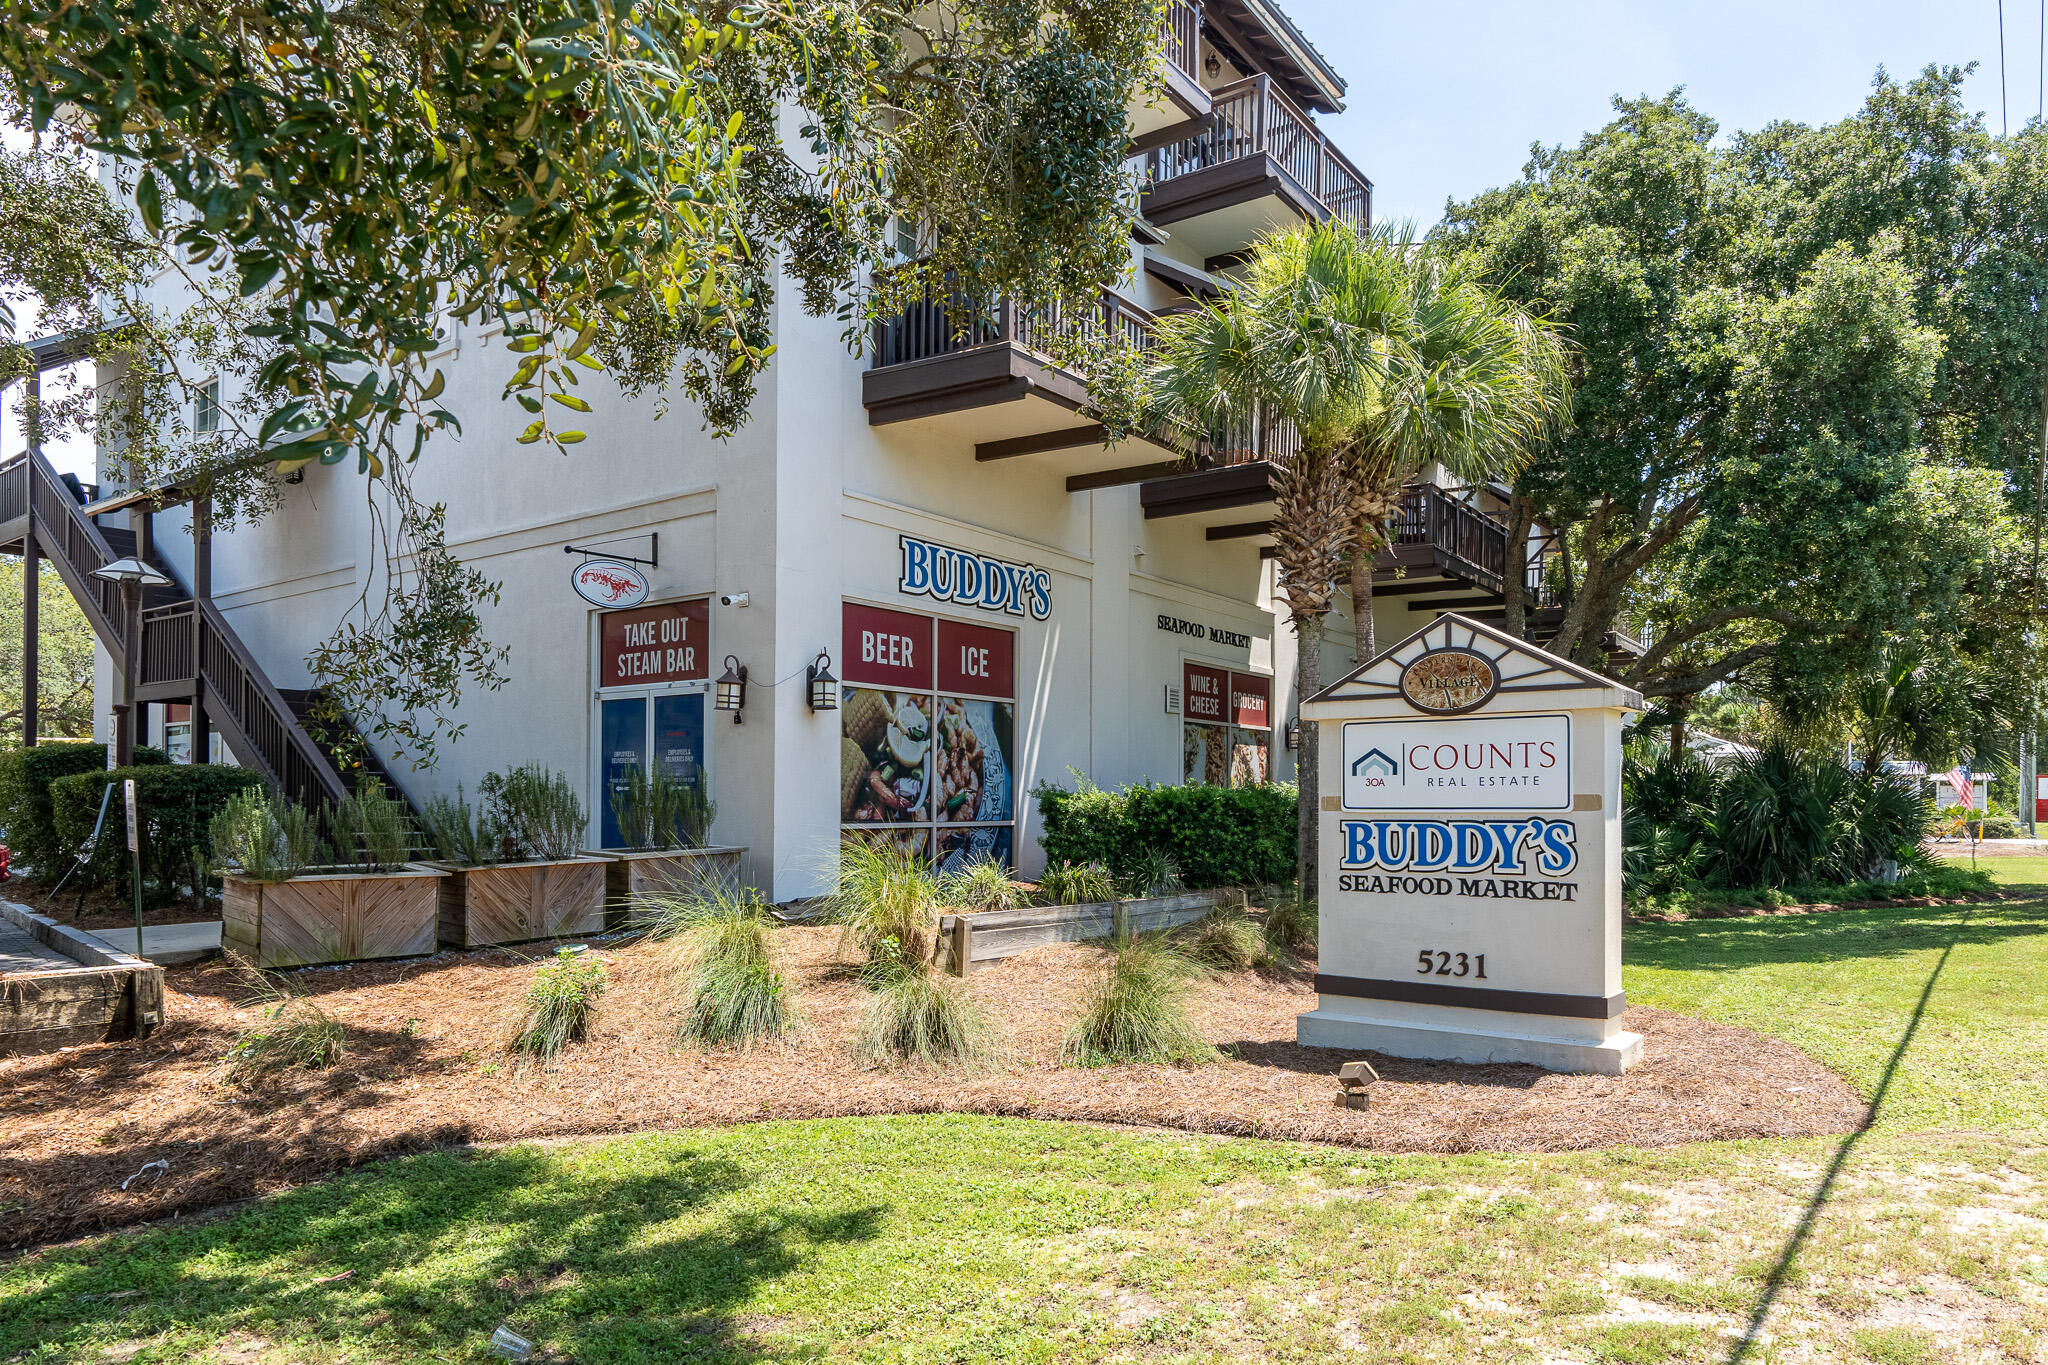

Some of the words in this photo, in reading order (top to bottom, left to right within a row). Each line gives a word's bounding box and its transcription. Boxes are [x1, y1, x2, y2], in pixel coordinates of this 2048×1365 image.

[900, 536, 1052, 620] BUDDY'S
[624, 621, 656, 647] TAKE
[661, 617, 688, 643] OUT
[1157, 614, 1205, 639] SEAFOOD
[1209, 627, 1250, 648] MARKET
[617, 650, 661, 677] STEAM
[666, 647, 695, 673] BAR
[862, 630, 914, 668] BEER
[961, 645, 989, 677] ICE
[1190, 673, 1211, 694] WINE
[1212, 678, 1219, 695] &
[1420, 677, 1477, 689] VILLAGE
[1190, 695, 1219, 716] CHEESE
[1233, 691, 1265, 712] GROCERY
[1409, 741, 1556, 771] COUNTS
[1427, 777, 1466, 787] REAL
[1479, 775, 1540, 787] ESTATE
[1340, 817, 1578, 876] BUDDY'S
[1338, 874, 1453, 895] SEAFOOD
[1456, 878, 1578, 902] MARKET
[1417, 949, 1488, 979] 5231
